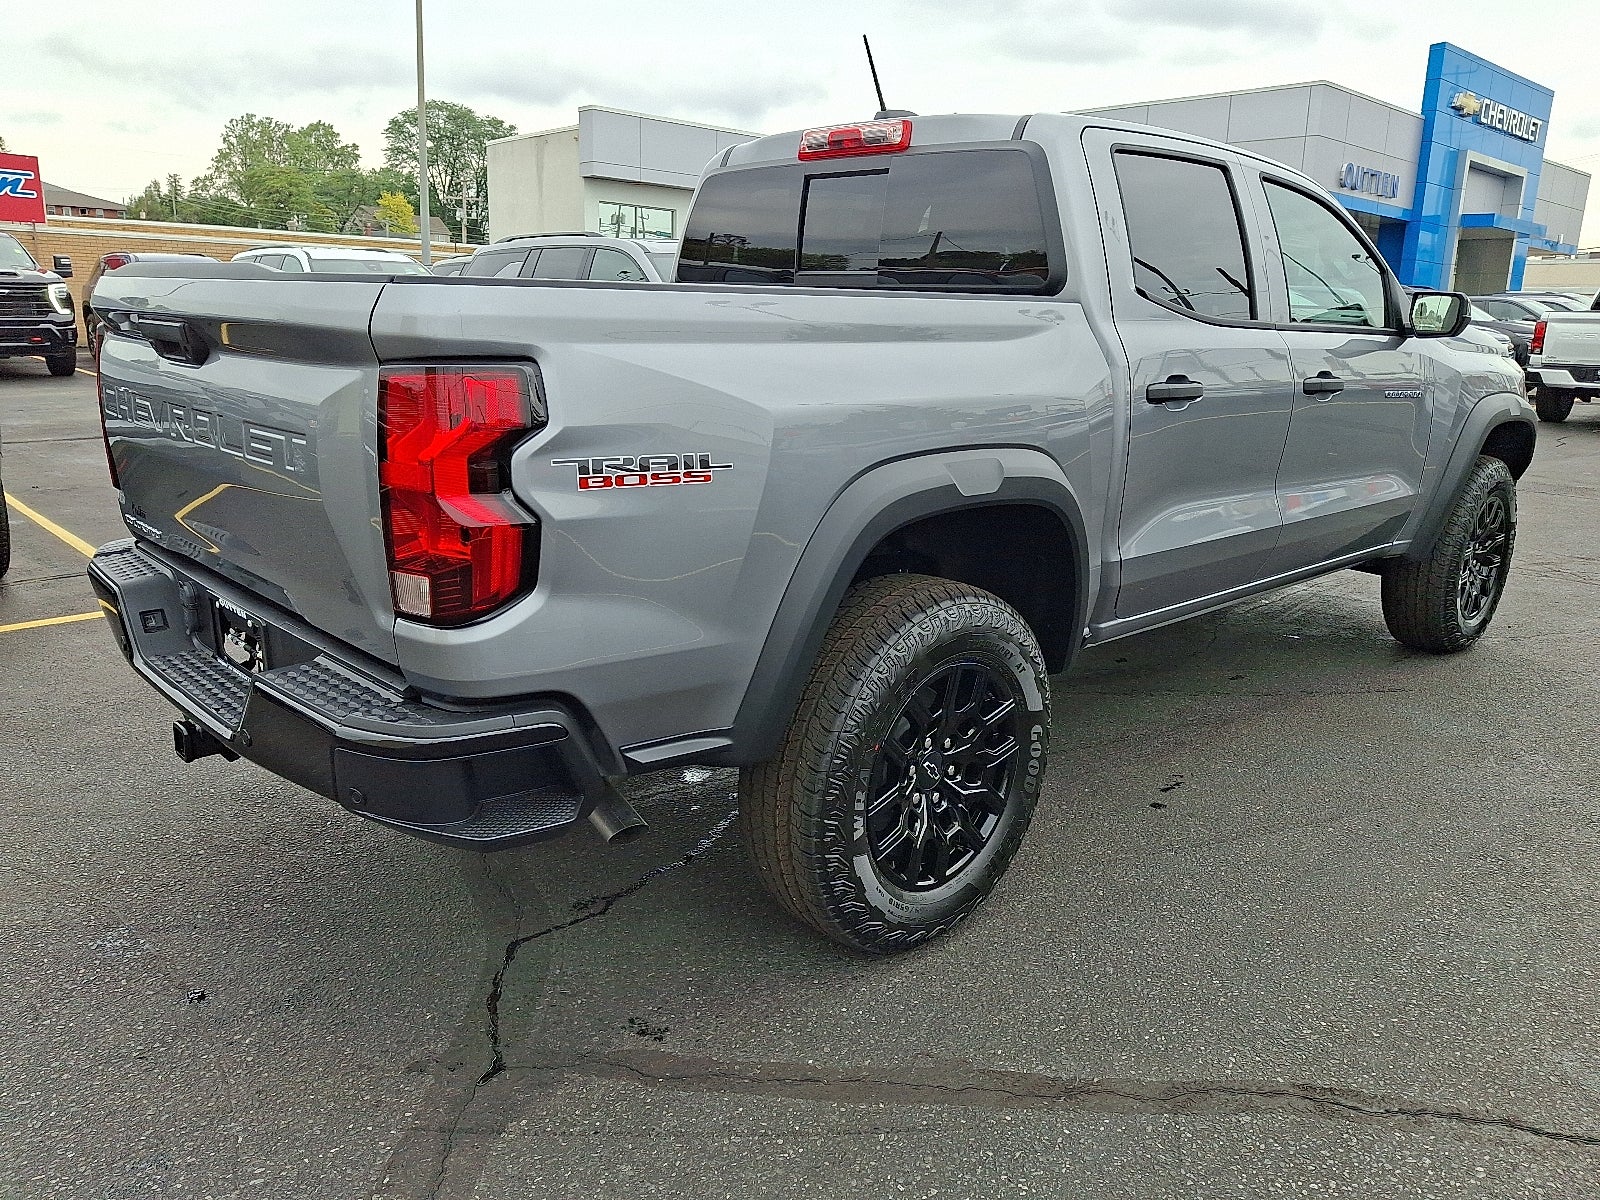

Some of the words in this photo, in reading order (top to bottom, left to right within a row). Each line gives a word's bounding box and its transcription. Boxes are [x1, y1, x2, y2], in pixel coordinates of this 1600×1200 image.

[1479, 98, 1543, 143] CHEVROLET
[101, 384, 307, 473] CHEVROLET
[551, 452, 734, 476] TRAIL
[577, 470, 713, 492] BOSS
